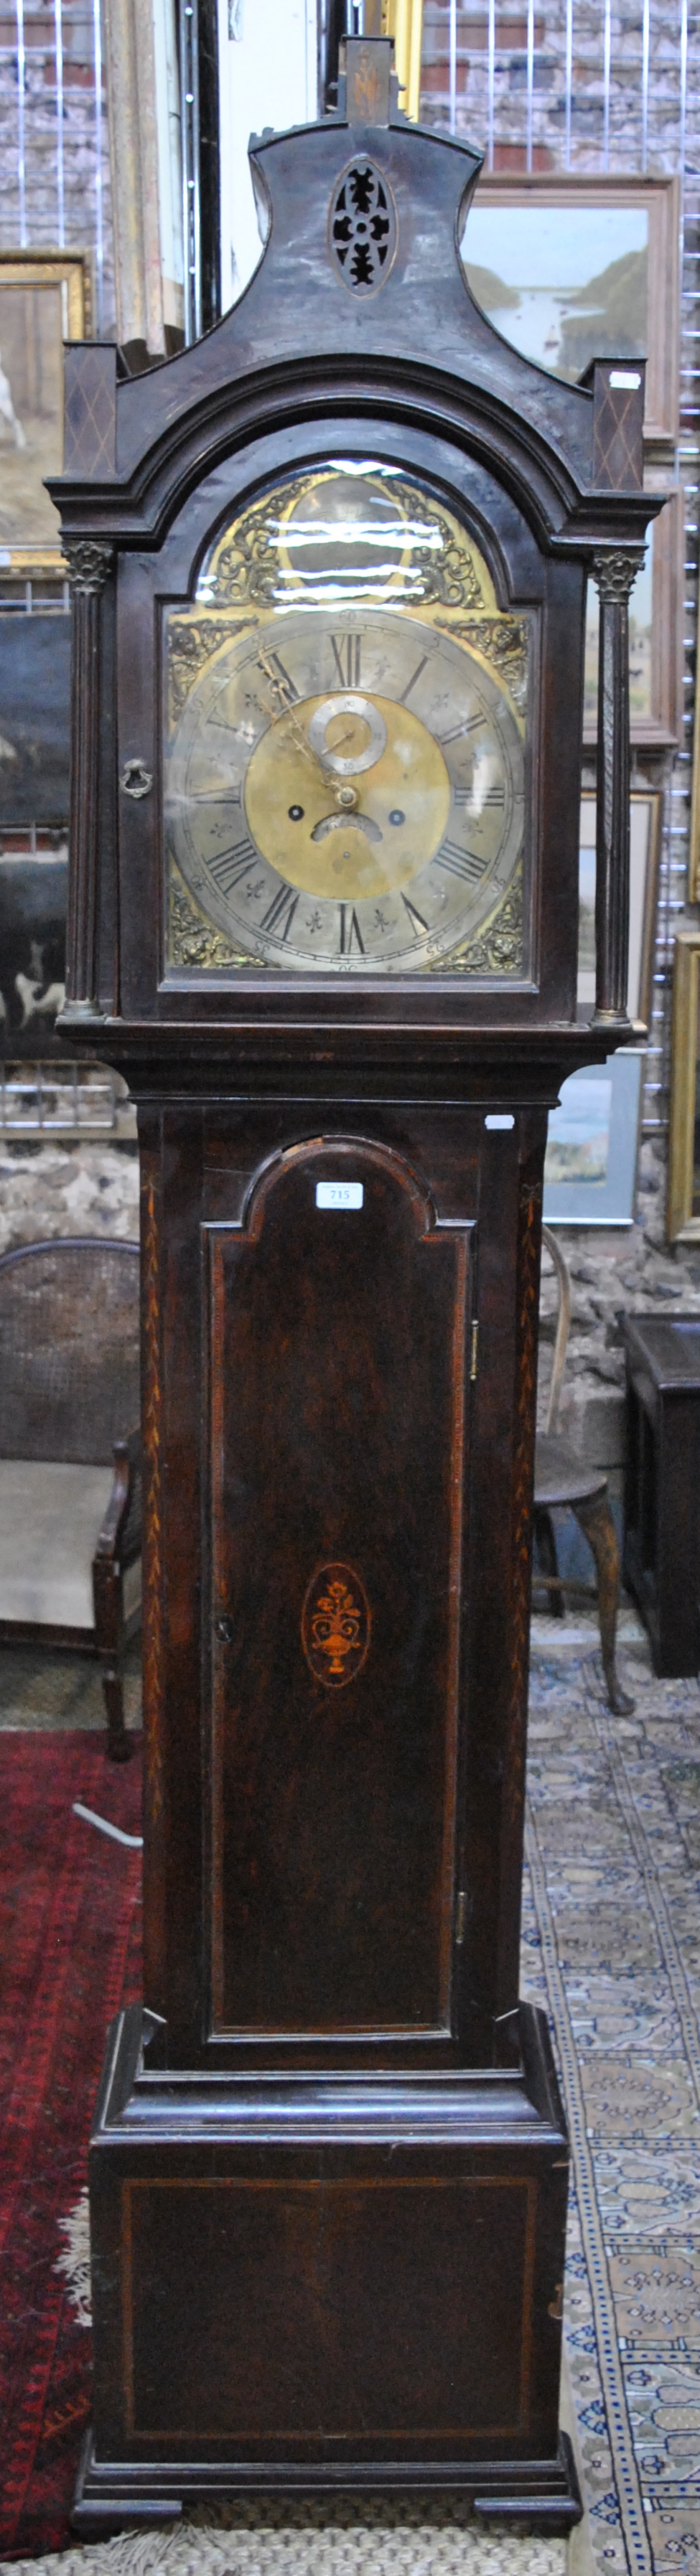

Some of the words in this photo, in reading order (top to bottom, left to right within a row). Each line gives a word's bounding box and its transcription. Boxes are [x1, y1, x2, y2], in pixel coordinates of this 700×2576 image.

[327, 633, 366, 689] XII
[433, 707, 489, 746] II
[453, 784, 505, 812] III
[201, 832, 258, 900] VIII
[253, 880, 300, 944] VII
[335, 903, 370, 954] VI
[400, 890, 437, 939] V
[255, 940, 270, 955] 35
[426, 941, 444, 956] 25
[330, 1190, 350, 1199] 715
